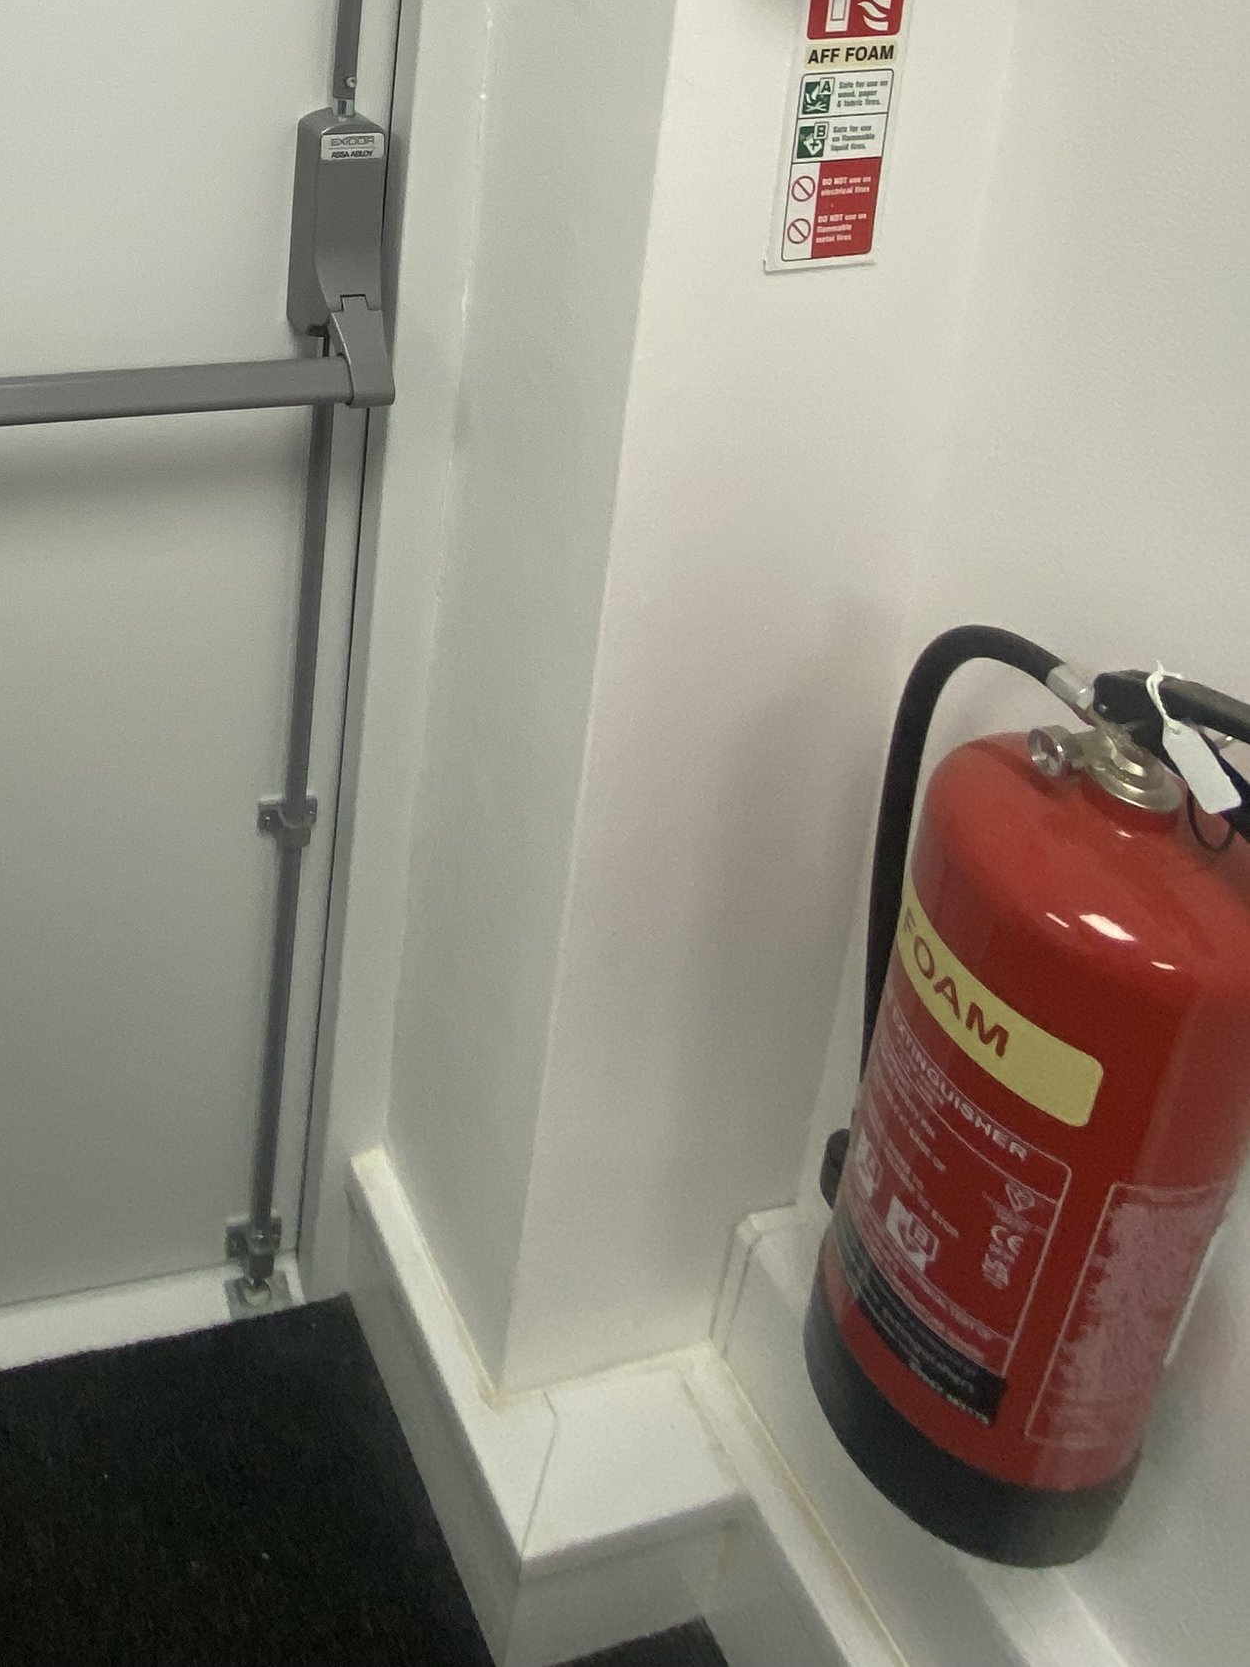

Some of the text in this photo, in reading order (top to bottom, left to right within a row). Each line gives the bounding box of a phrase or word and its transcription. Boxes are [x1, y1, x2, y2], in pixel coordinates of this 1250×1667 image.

[808, 45, 894, 64] AFF FOAM
[821, 81, 831, 93] A
[816, 125, 826, 137] B
[331, 150, 373, 159] ASSA ABLOY
[903, 906, 1010, 1057] FOAM
